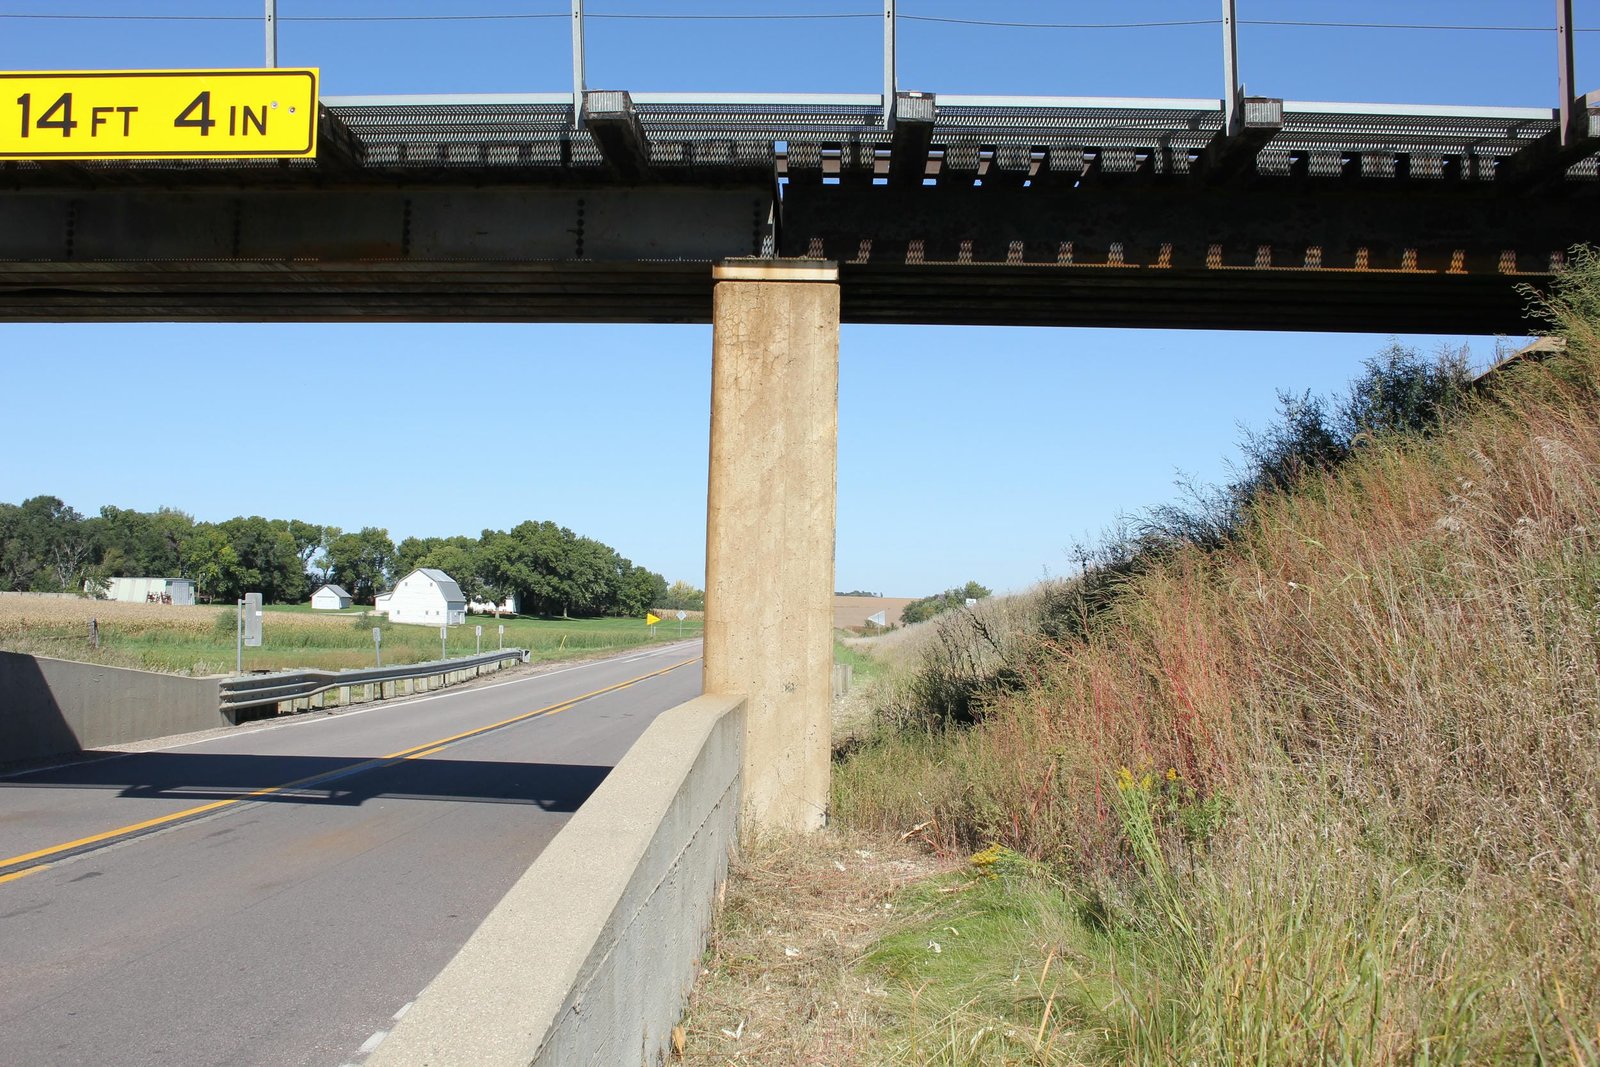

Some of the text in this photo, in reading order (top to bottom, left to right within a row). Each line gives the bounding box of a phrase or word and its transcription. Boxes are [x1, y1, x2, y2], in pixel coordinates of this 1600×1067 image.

[17, 91, 268, 138] 14 FT 4 IN
